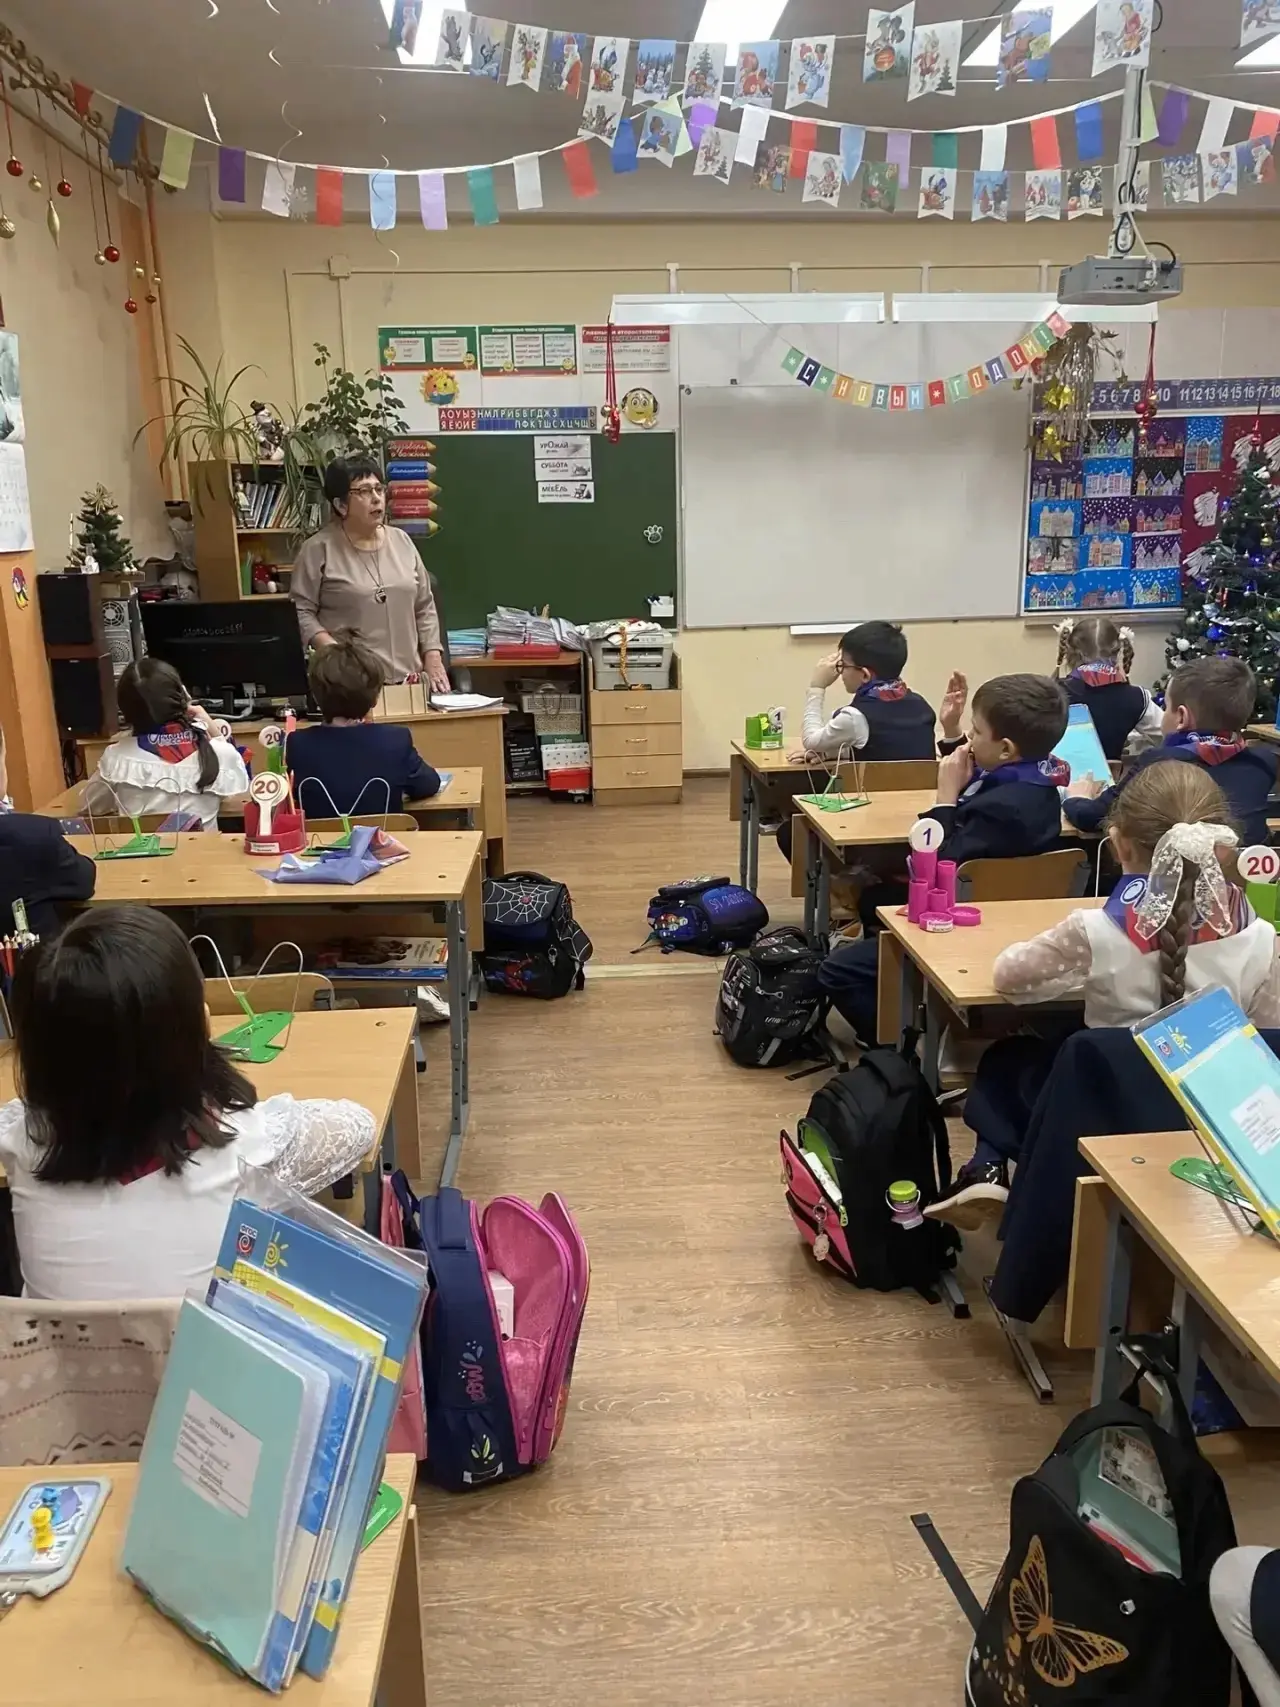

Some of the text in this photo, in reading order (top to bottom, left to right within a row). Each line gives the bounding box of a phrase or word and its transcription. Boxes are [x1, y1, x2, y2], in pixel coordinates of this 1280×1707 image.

[802, 327, 1052, 405] С НОВЫМ ГОДОМ!
[1099, 389, 1106, 403] 5
[1122, 389, 1129, 403] 7
[1133, 389, 1141, 402] 8
[1180, 387, 1189, 400] 11
[1192, 387, 1202, 400] 12
[1204, 387, 1215, 400] 13
[1218, 386, 1228, 399] 14
[1231, 386, 1241, 399] 15
[1244, 385, 1254, 399] 16
[1257, 385, 1267, 398] 17
[774, 711, 781, 721] 1
[264, 731, 281, 746] 20
[254, 780, 278, 794] 20
[922, 827, 932, 845] 1
[1246, 855, 1275, 876] 20
